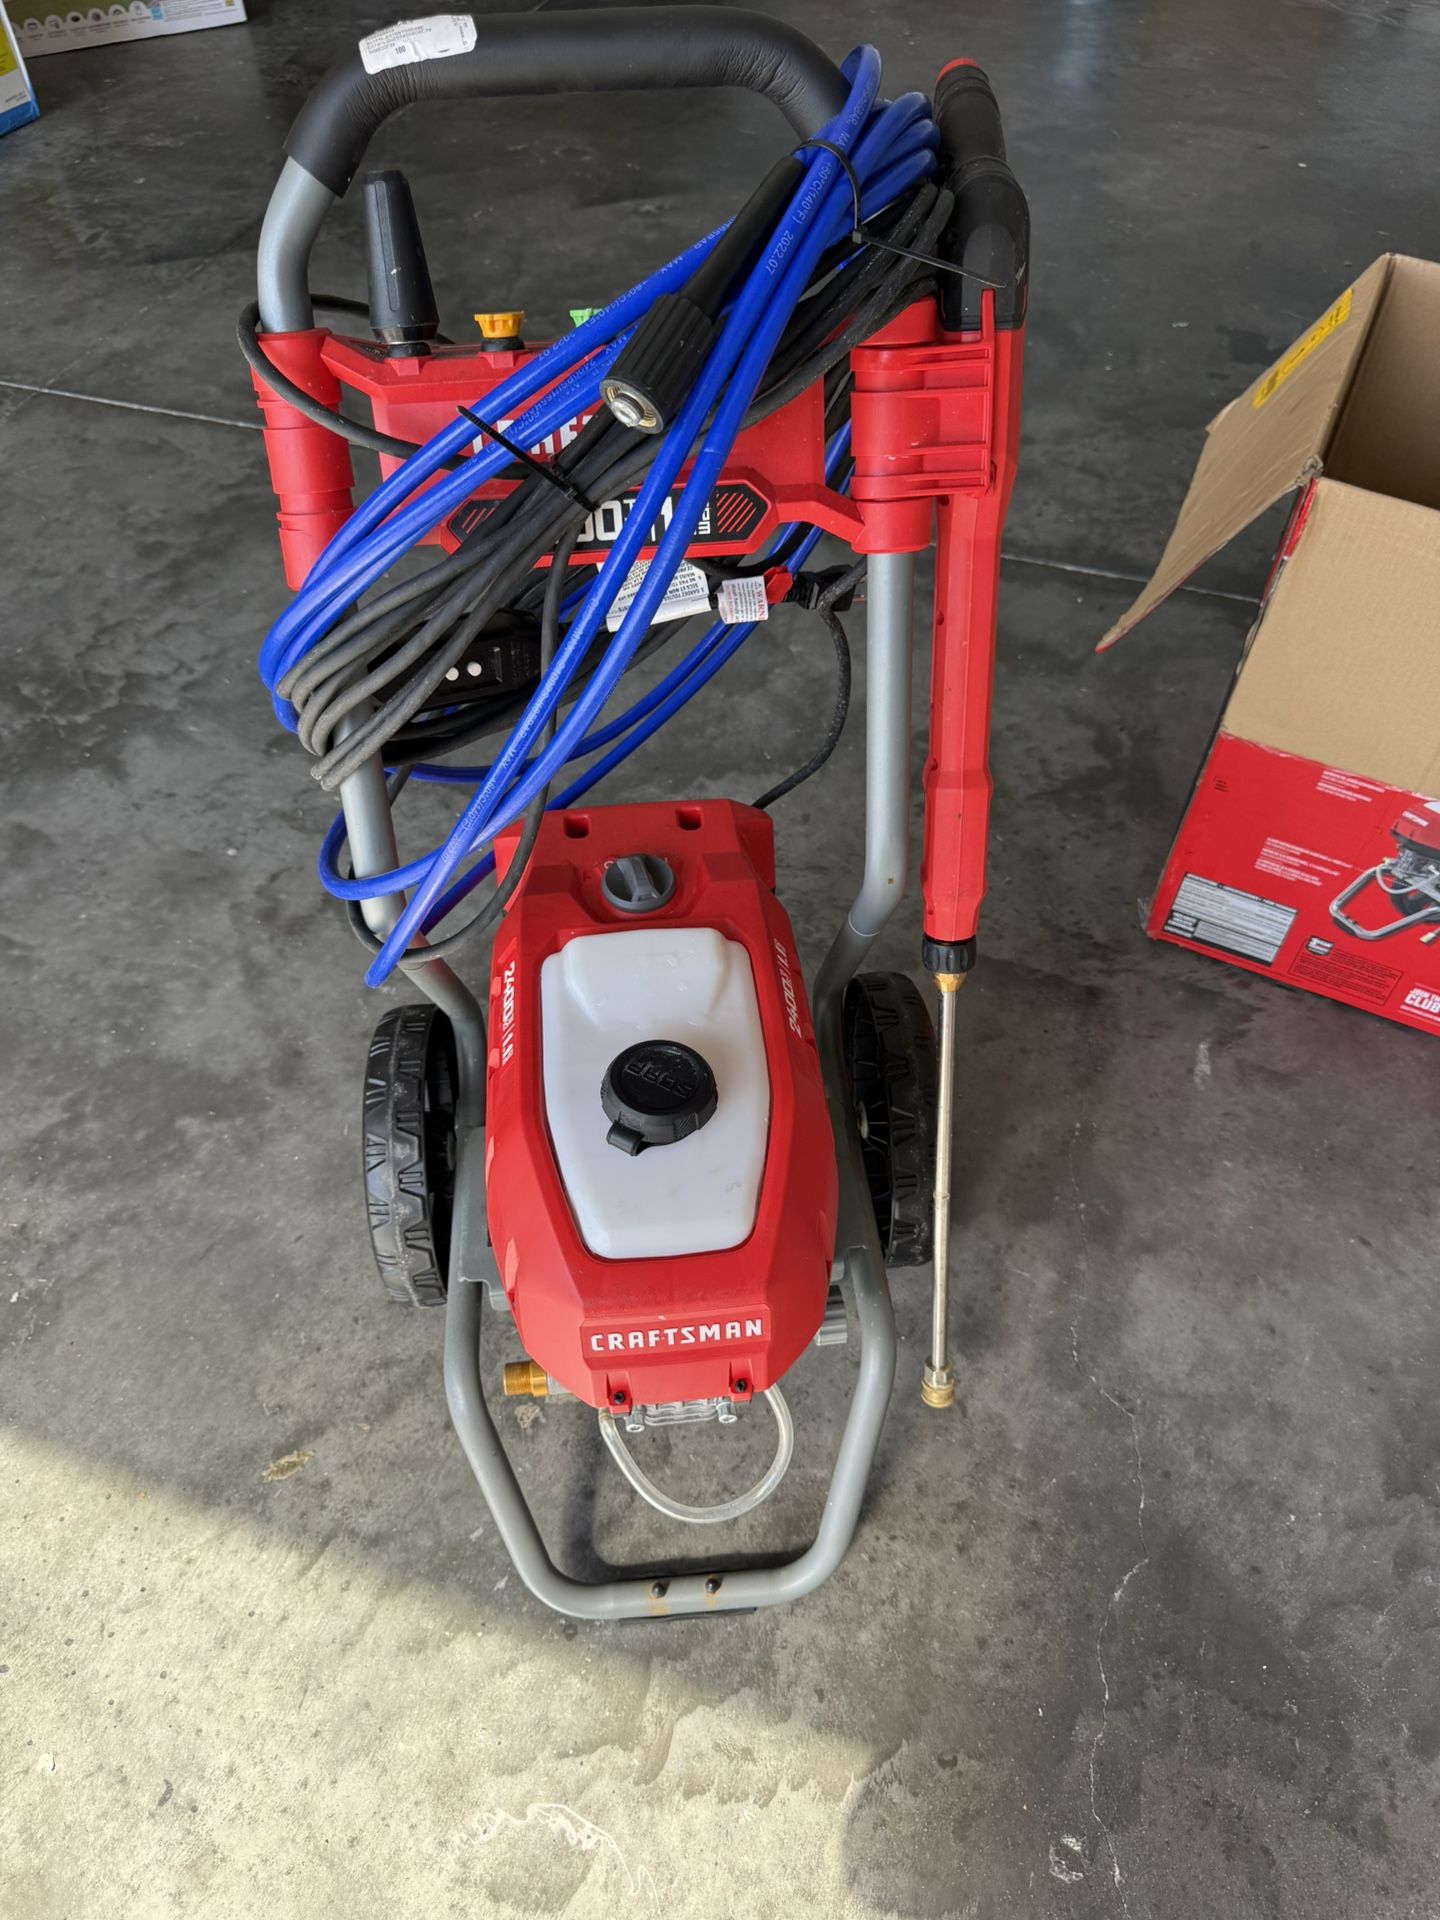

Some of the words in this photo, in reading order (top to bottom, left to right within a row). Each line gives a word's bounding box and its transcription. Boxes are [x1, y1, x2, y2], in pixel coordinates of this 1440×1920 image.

[766, 229, 796, 277] 2022.07
[1404, 993, 1440, 1014] CLUB
[625, 1061, 692, 1099] SOAP
[590, 1318, 763, 1352] CRAFTSMAN
